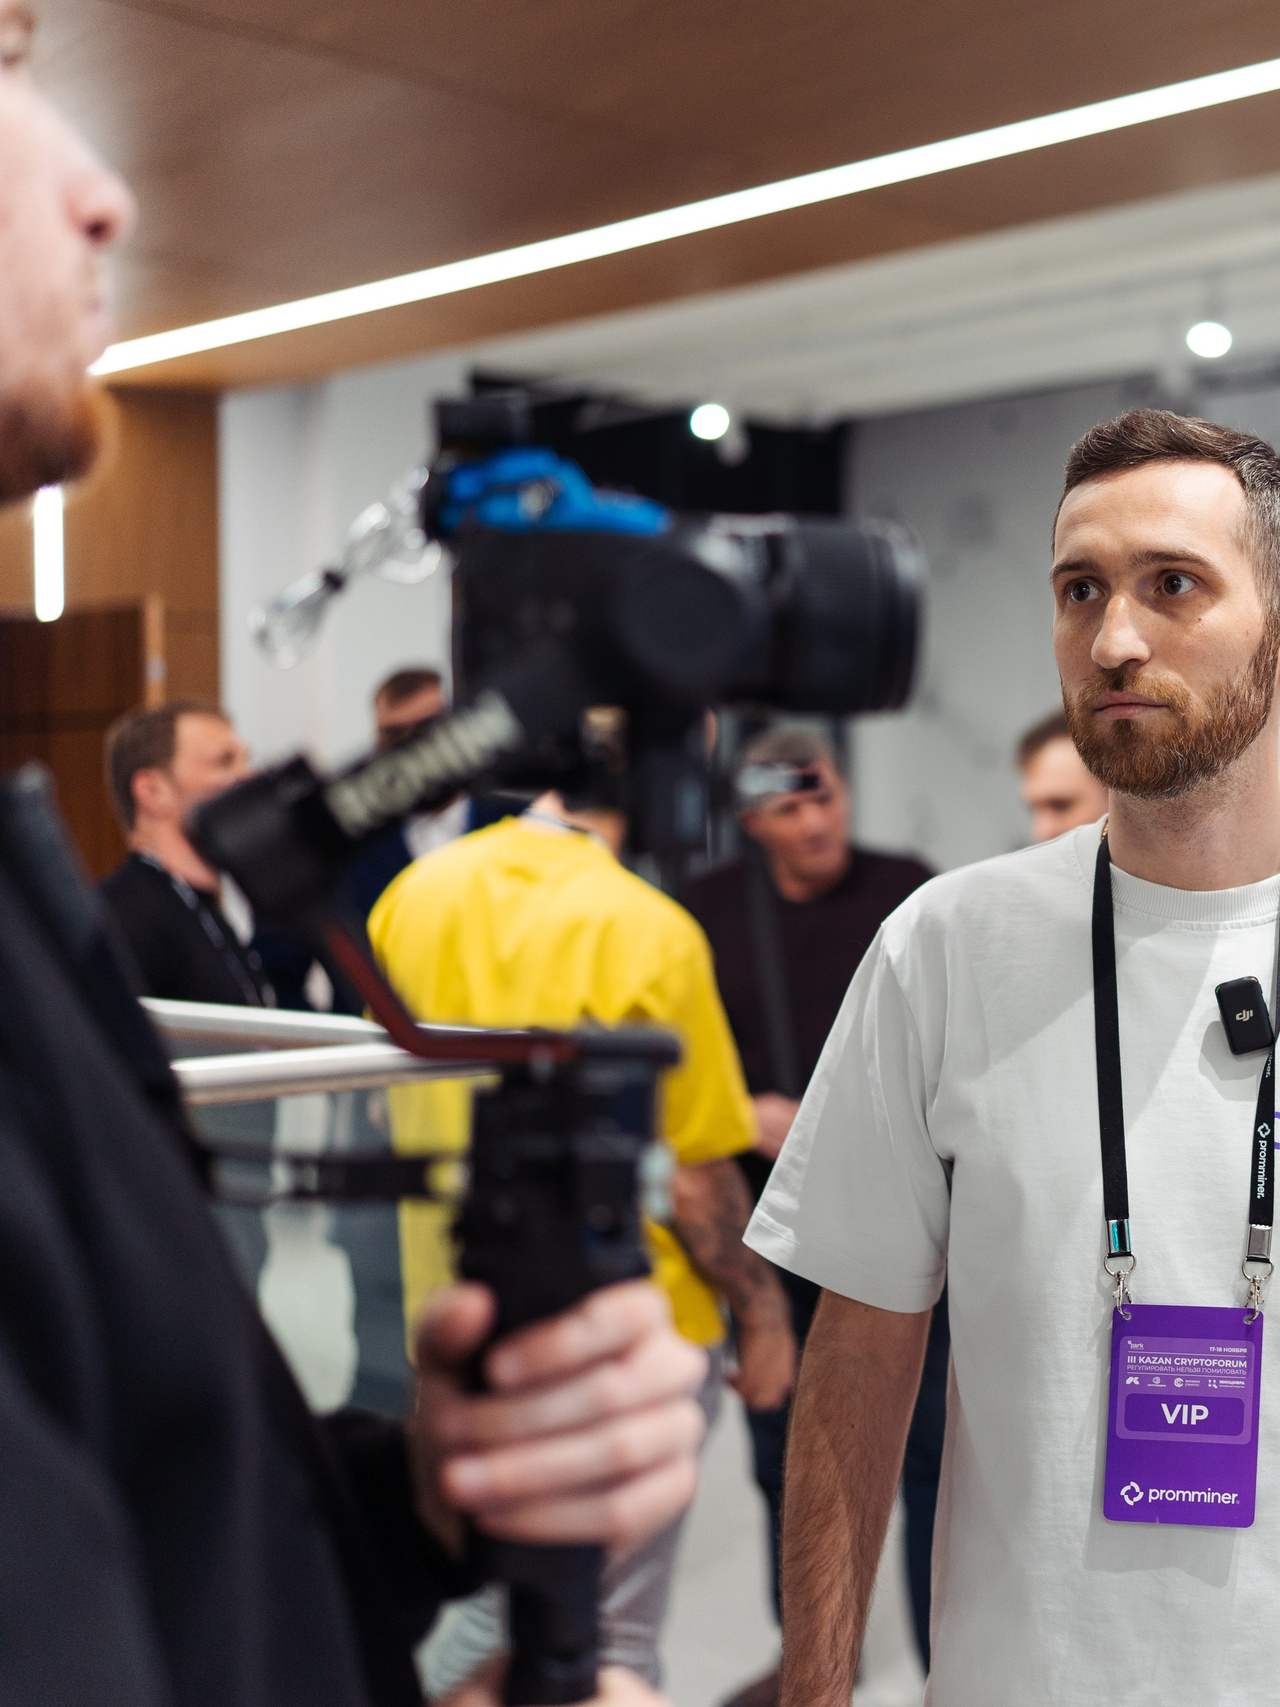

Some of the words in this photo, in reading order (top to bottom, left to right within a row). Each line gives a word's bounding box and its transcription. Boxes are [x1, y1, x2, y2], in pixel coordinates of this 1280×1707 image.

[1127, 1356, 1136, 1364] III
[1138, 1356, 1172, 1365] KAZAN
[1174, 1358, 1247, 1368] CRYPTOFORUM
[1127, 1364, 1175, 1372] РЕГУЛИРОВАТЬ
[1202, 1367, 1246, 1375] ПОМИЛОВАТЬ
[1161, 1403, 1209, 1425] VIP
